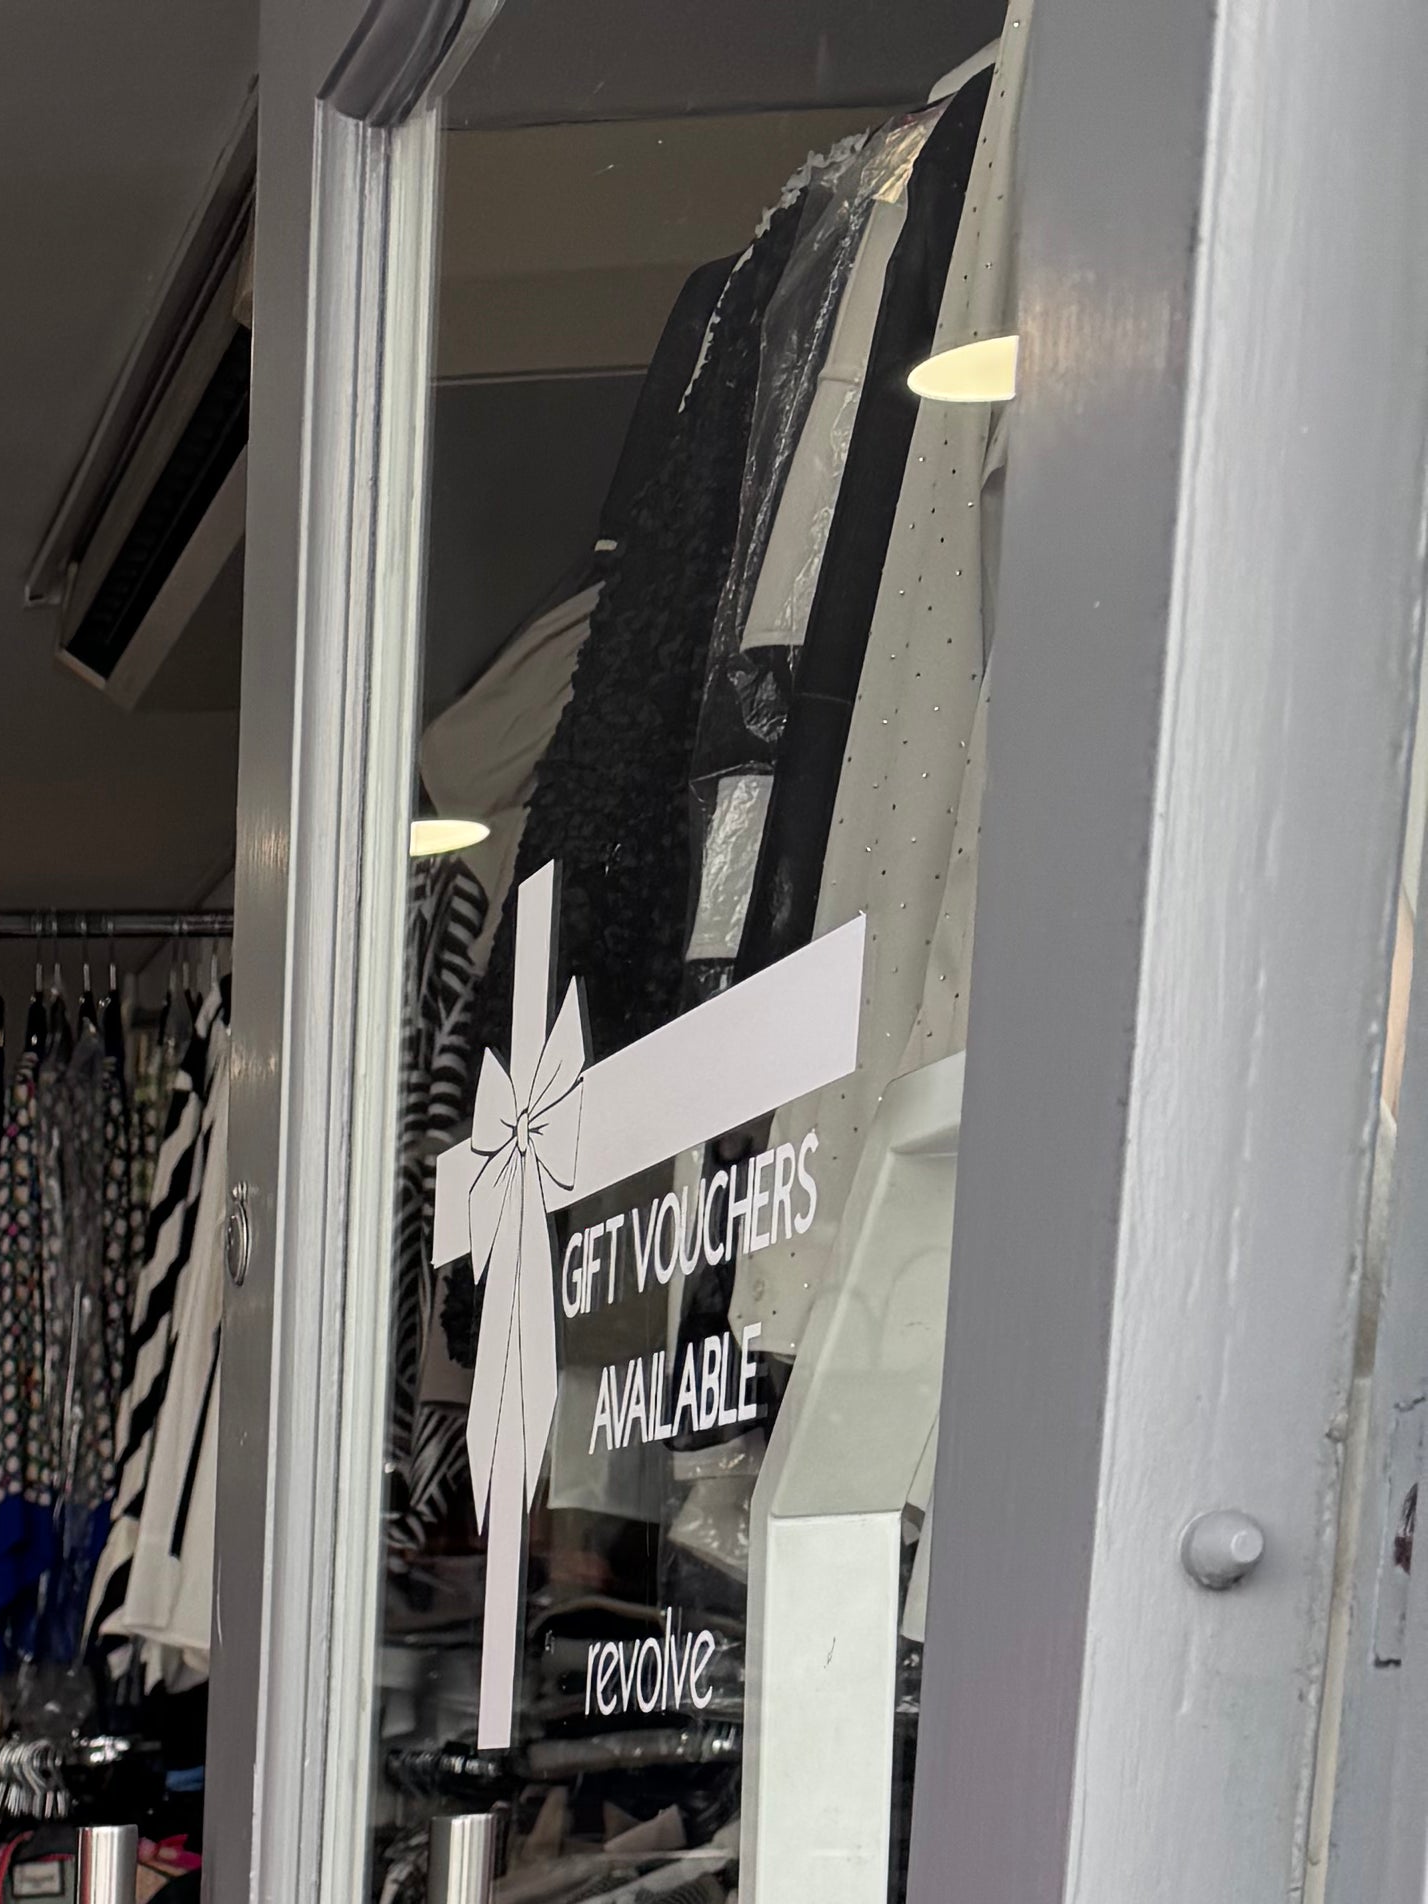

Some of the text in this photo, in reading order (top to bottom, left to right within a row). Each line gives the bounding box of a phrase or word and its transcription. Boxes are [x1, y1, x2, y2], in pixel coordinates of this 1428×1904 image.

[562, 1132, 819, 1319] GIFT VOUCHERS
[588, 1321, 762, 1455] AVAILABLE
[584, 1606, 716, 1716] revolve
